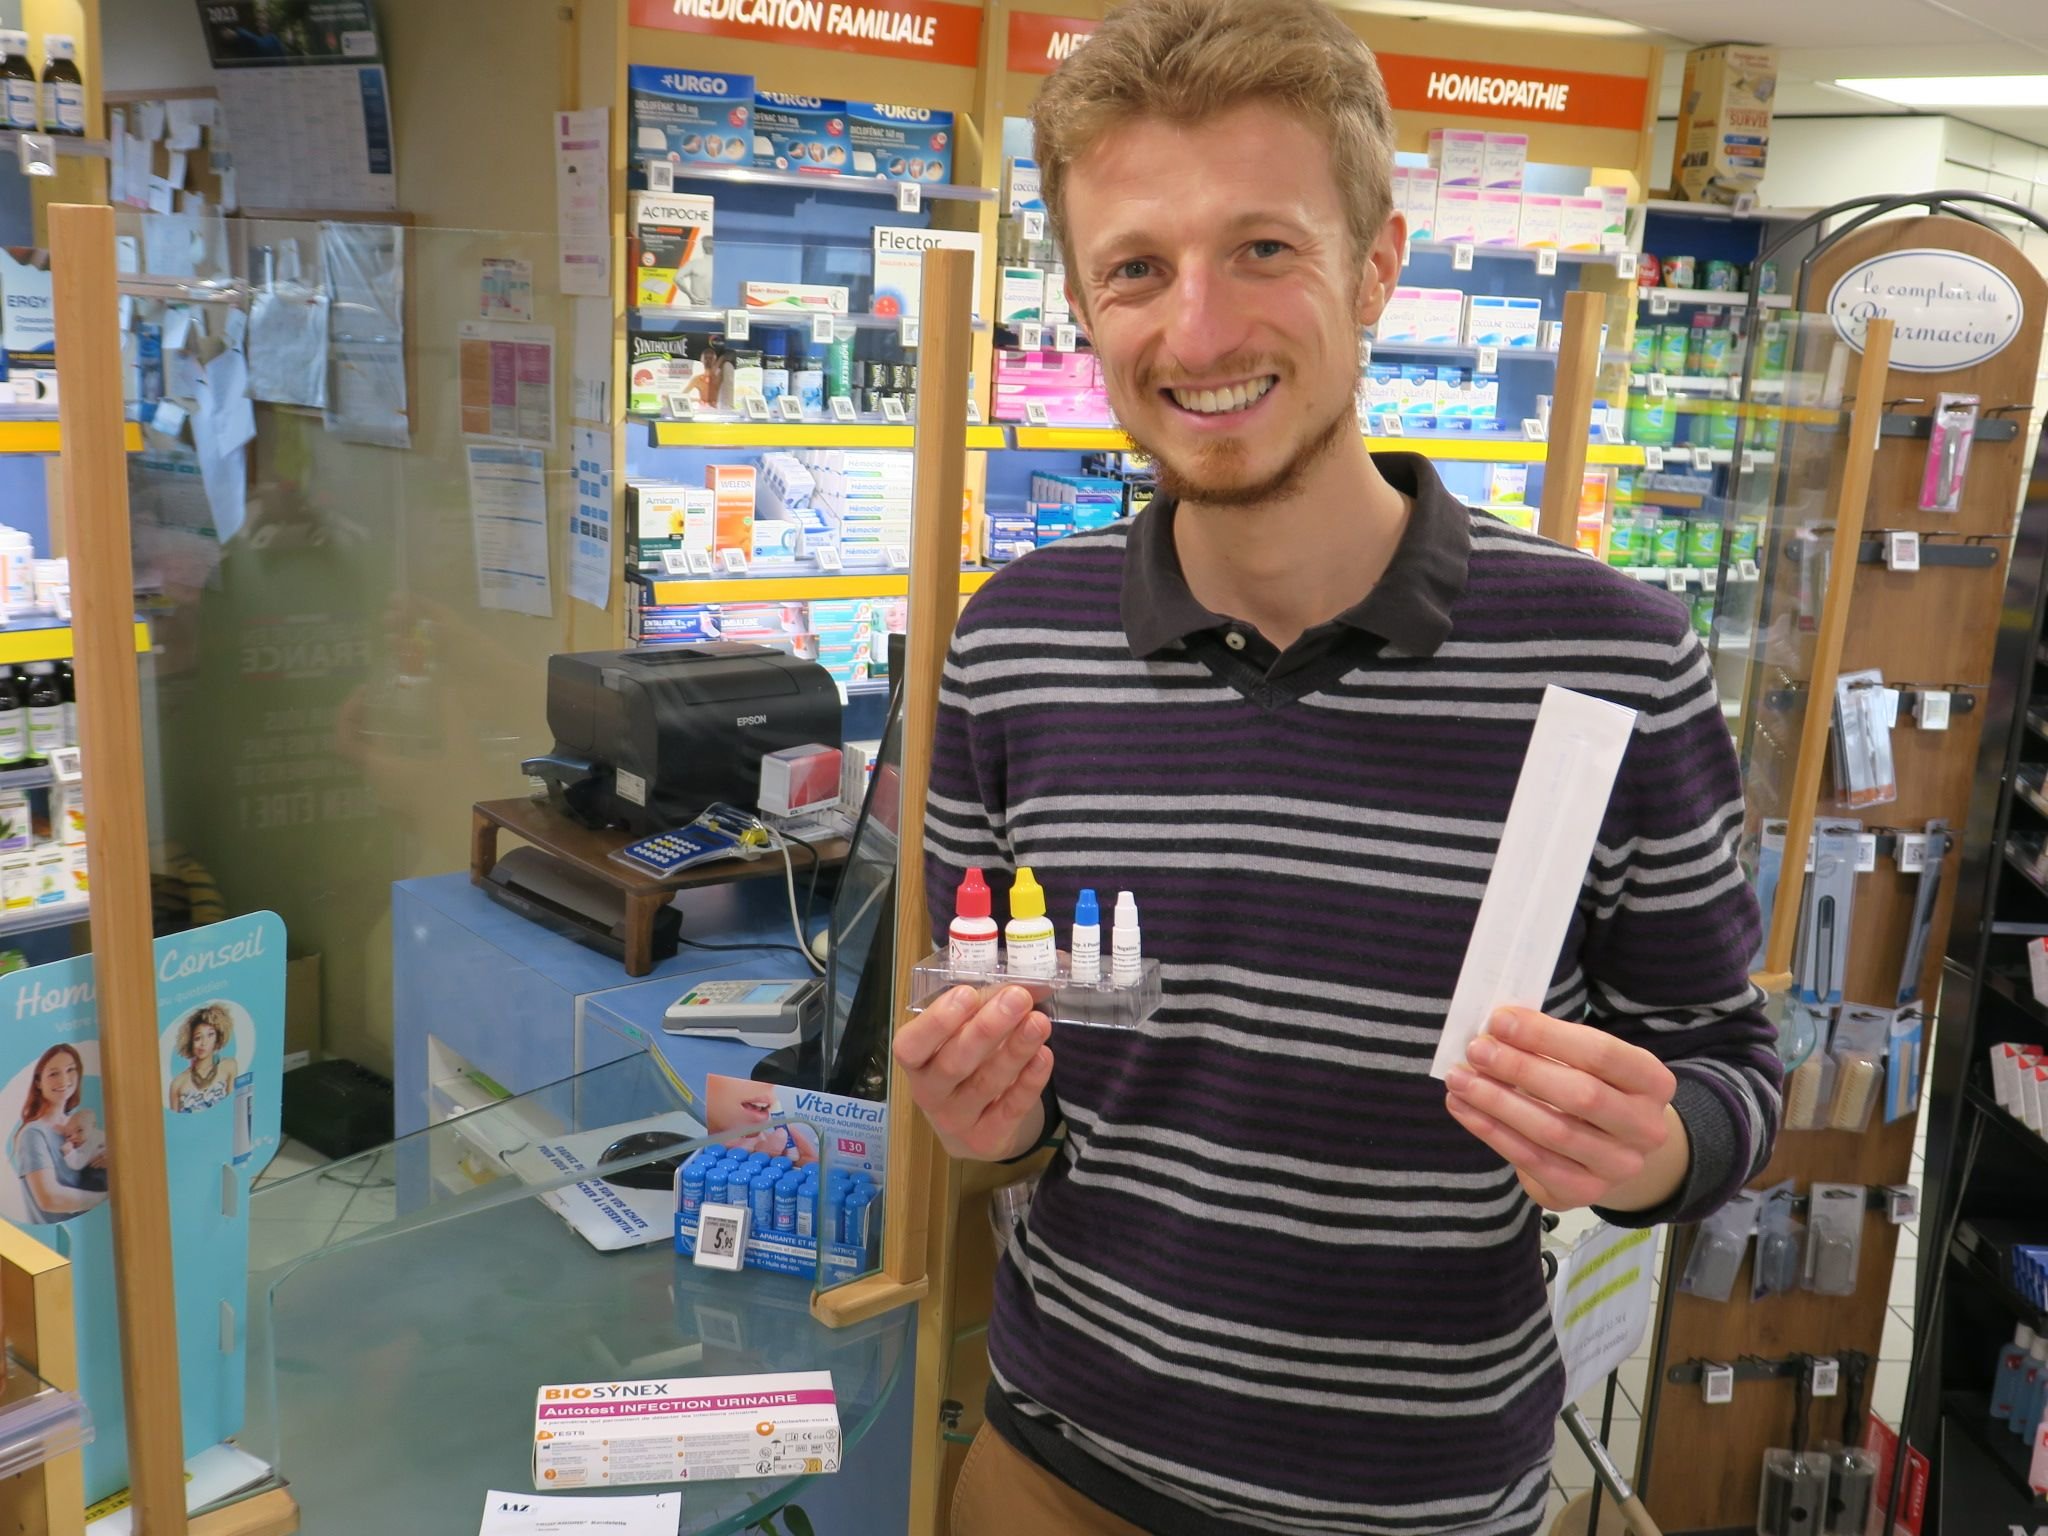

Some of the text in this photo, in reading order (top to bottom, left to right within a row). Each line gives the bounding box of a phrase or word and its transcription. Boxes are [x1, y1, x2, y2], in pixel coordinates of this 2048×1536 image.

[674, 0, 938, 46] MEDICATION FAMILIALE
[675, 75, 728, 95] URGO
[1427, 72, 1569, 111] HOMEOPATHIE
[770, 92, 821, 108] URGO
[885, 103, 931, 121] URGO
[642, 206, 710, 221] ACTIPOCHE
[879, 231, 942, 250] Flector
[1863, 270, 1998, 307] le comptoir du
[1850, 301, 1998, 345] Prmacien
[737, 714, 767, 727] EPSON
[159, 924, 265, 983] Conseil
[837, 1118, 884, 1133] NOURRISSANT
[848, 1142, 862, 1153] 30
[622, 1208, 648, 1229] ACHATS
[760, 1234, 795, 1245] APAISANTE
[545, 1384, 669, 1400] BIOSYNEX
[545, 1393, 798, 1417] Autotest INFECTION URINAIRE
[680, 1468, 687, 1478] 4
[498, 1503, 531, 1512] AAZ
